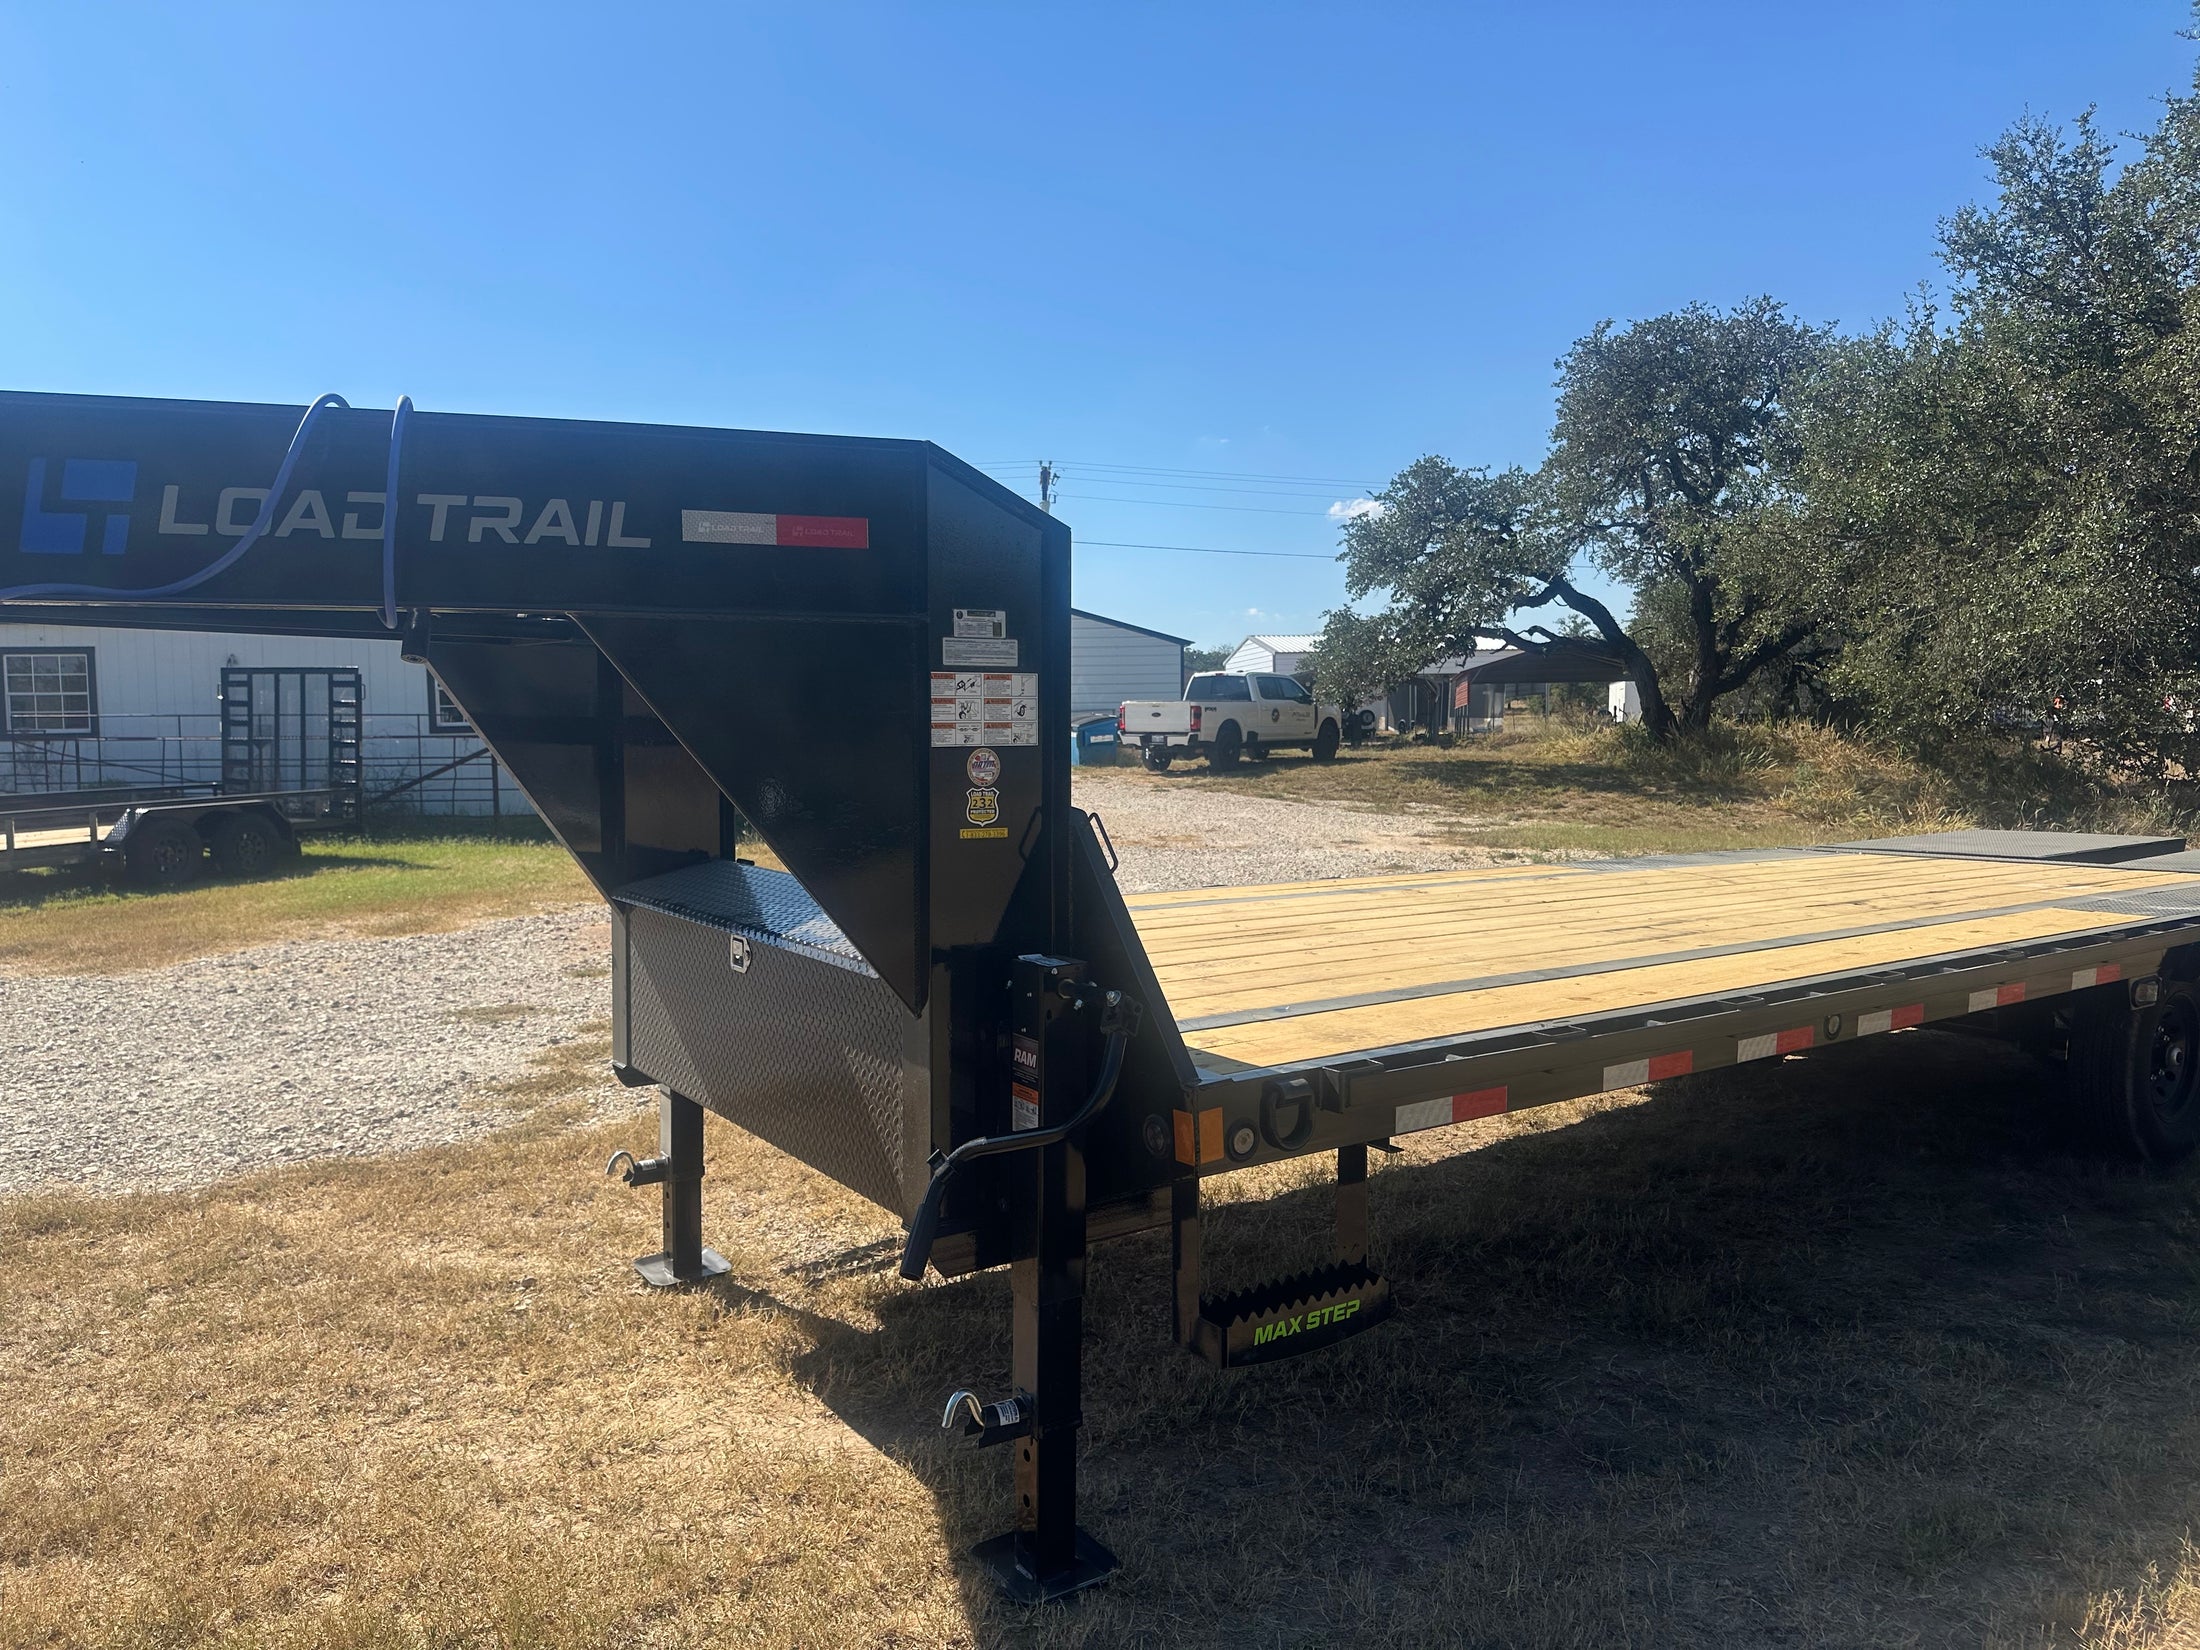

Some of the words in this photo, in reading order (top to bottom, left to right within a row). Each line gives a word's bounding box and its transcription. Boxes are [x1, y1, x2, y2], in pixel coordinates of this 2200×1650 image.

[158, 485, 398, 540] LOAD
[417, 493, 652, 549] TRAIL
[738, 526, 765, 534] TRAIL
[805, 528, 828, 536] LOAD
[972, 798, 993, 808] 232
[1014, 1048, 1037, 1068] RAM
[1254, 1315, 1303, 1346] MAX
[1306, 1300, 1361, 1330] STEP
